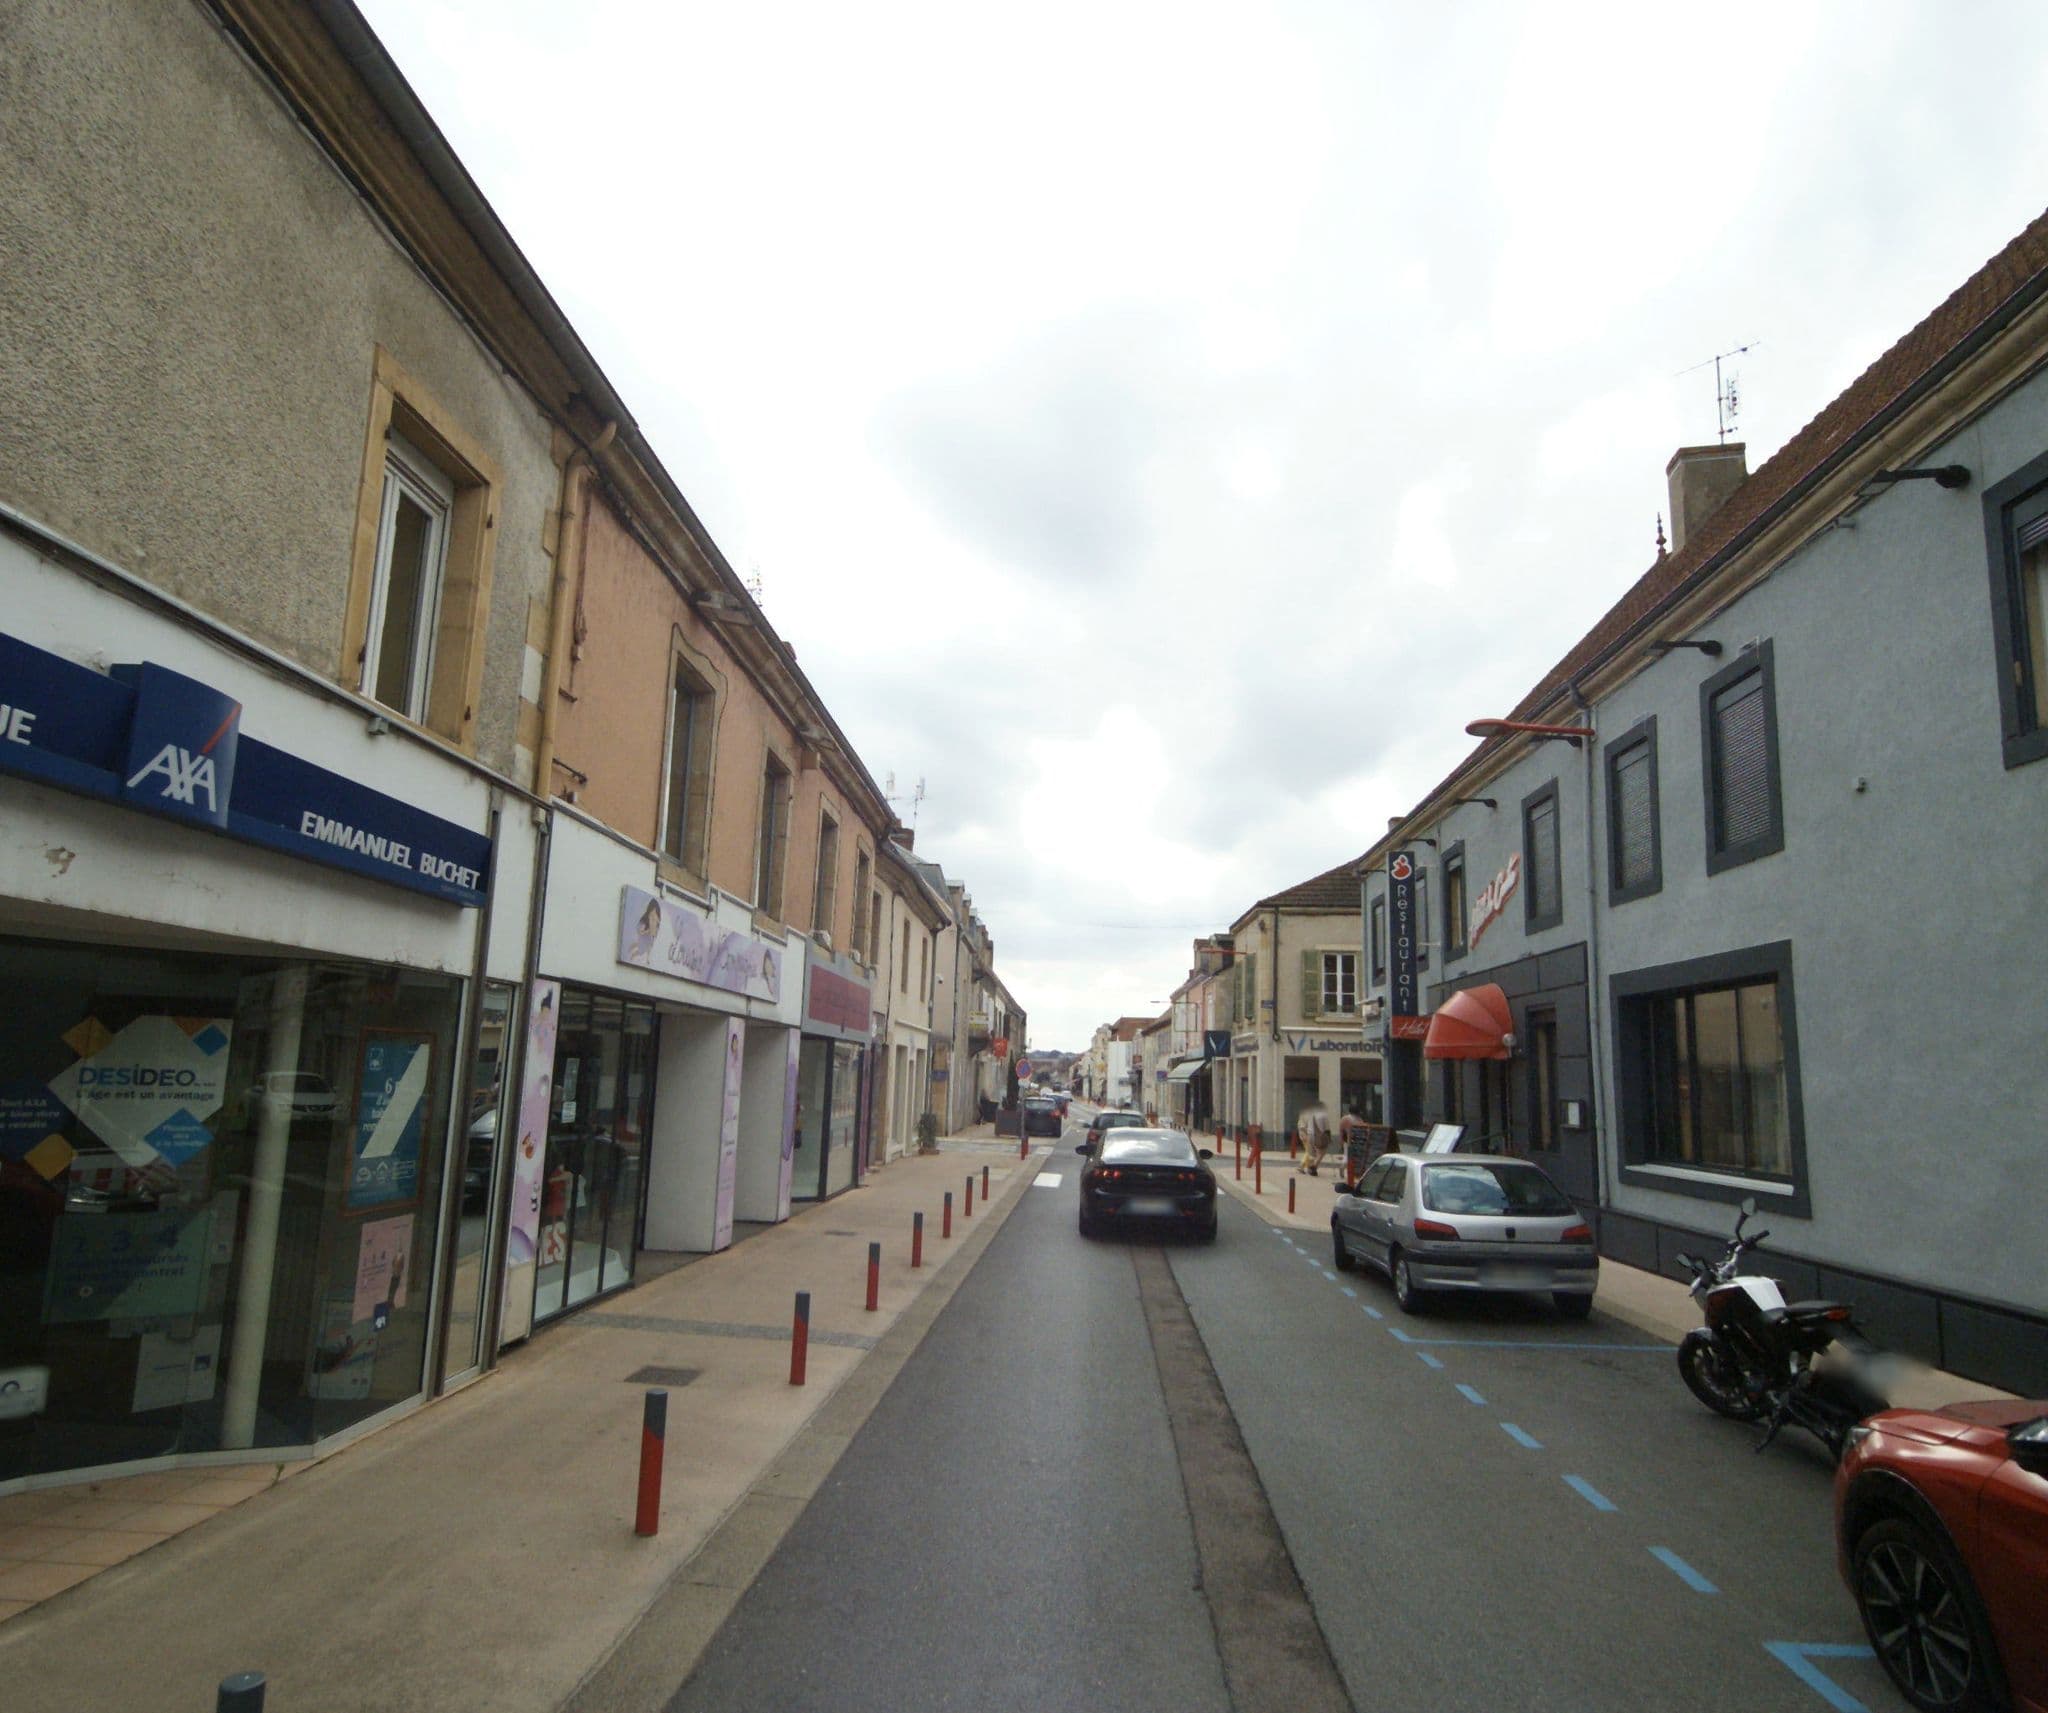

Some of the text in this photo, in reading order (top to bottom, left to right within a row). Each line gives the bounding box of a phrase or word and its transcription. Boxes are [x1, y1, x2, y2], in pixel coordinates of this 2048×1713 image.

[127, 743, 216, 812] AXA
[301, 810, 481, 890] EMMANUEL BUCHET
[1397, 885, 1412, 1012] Restaurant
[1310, 1038, 1384, 1054] Laboratoir
